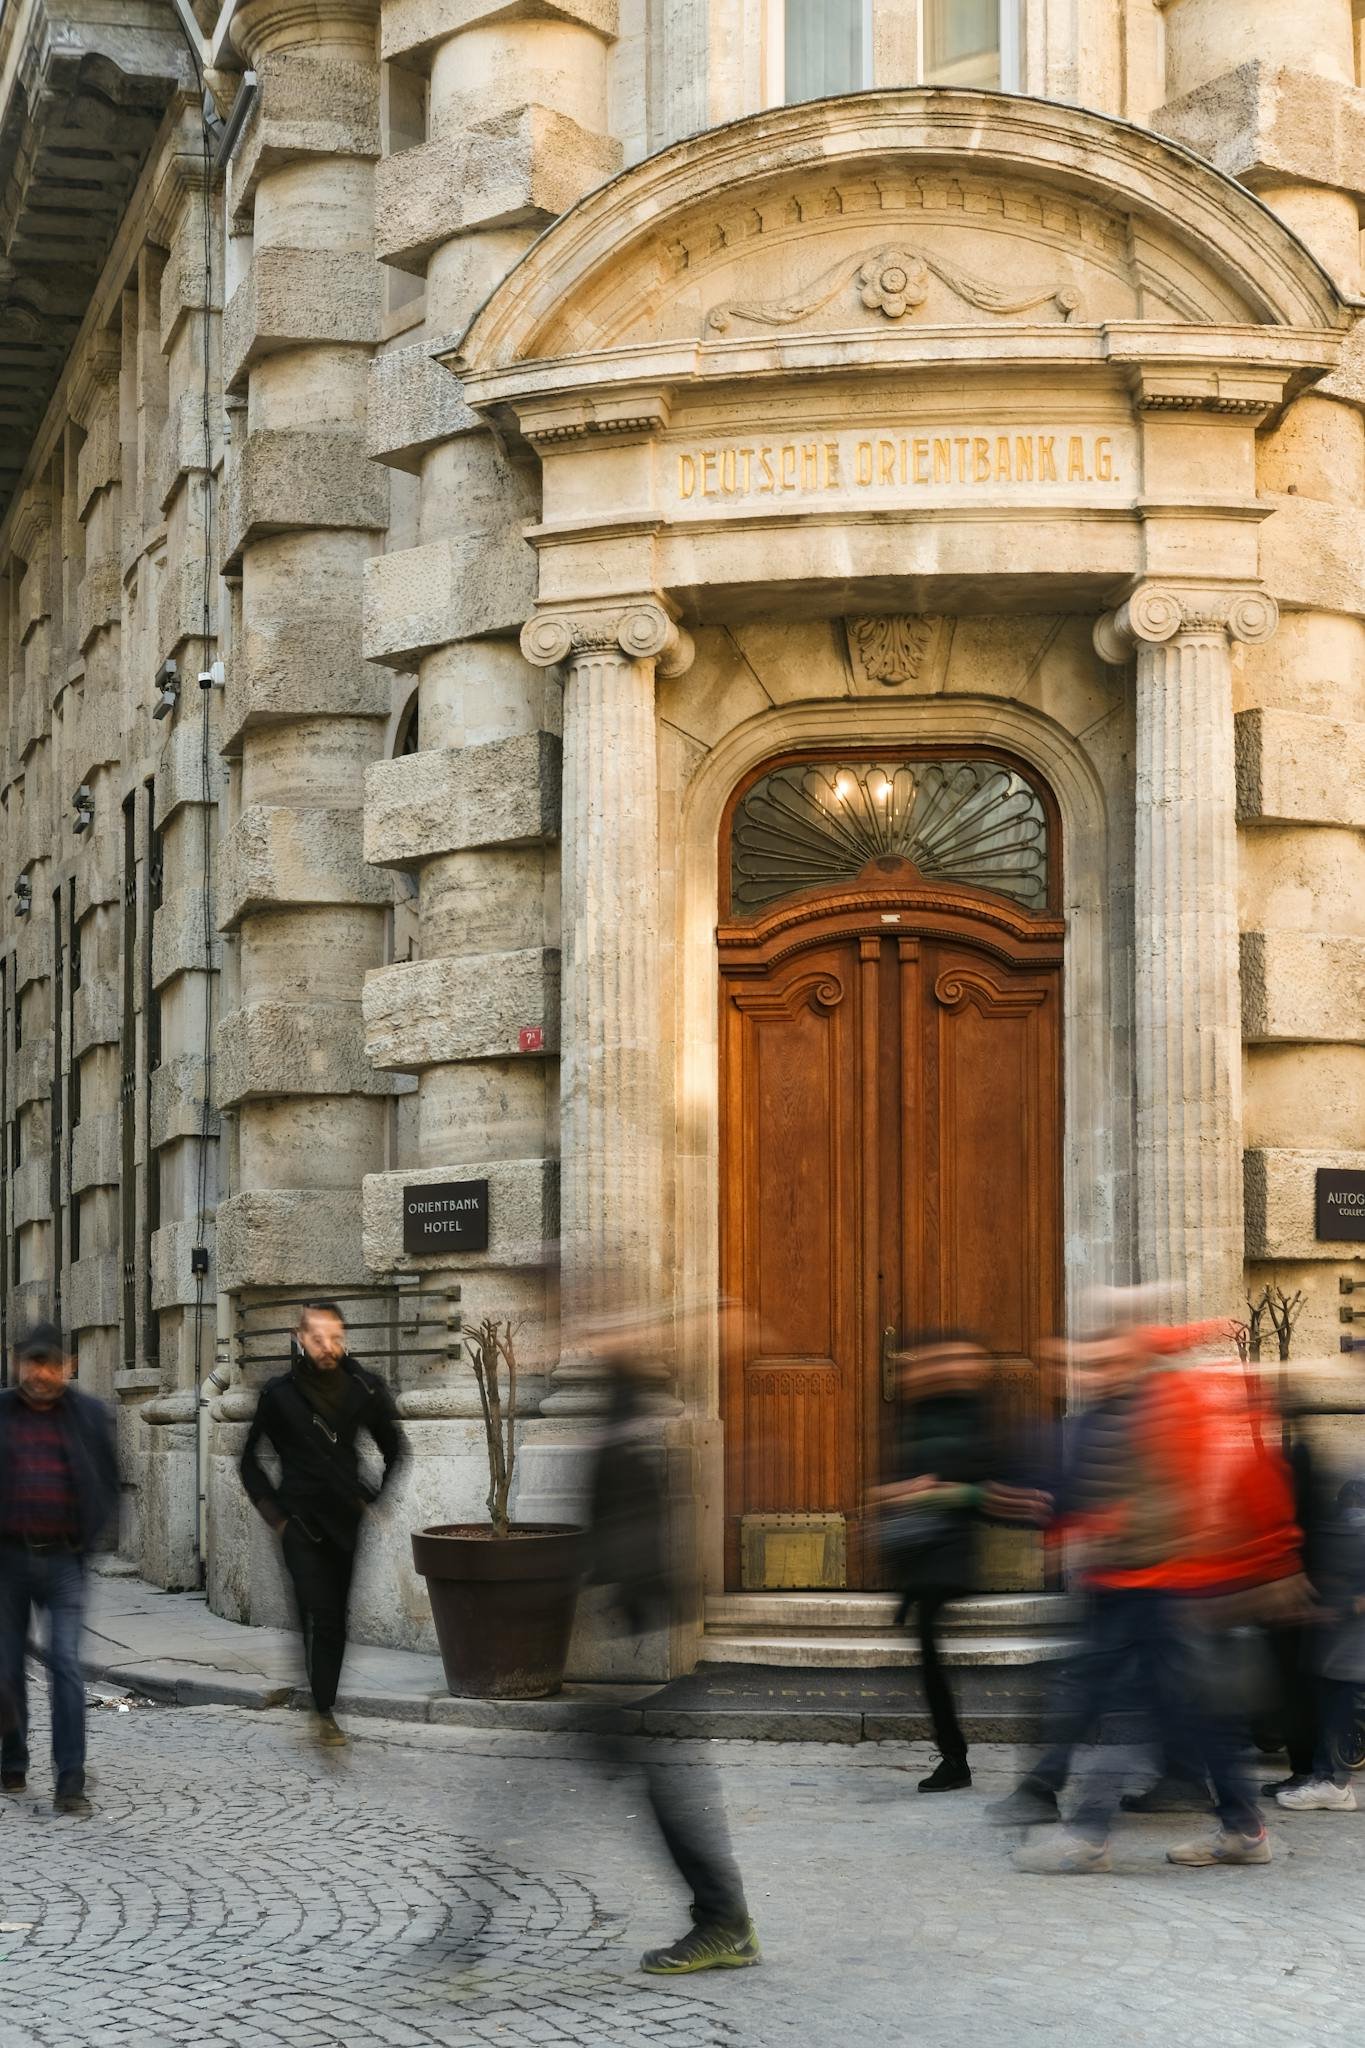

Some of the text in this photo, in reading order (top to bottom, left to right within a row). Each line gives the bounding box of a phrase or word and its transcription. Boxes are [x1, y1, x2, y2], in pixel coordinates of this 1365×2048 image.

[679, 435, 1121, 500] DEUTSCHE ORIENTBANK A.G.
[408, 1198, 479, 1214] ORIENTBANK
[423, 1221, 462, 1234] HOTEL
